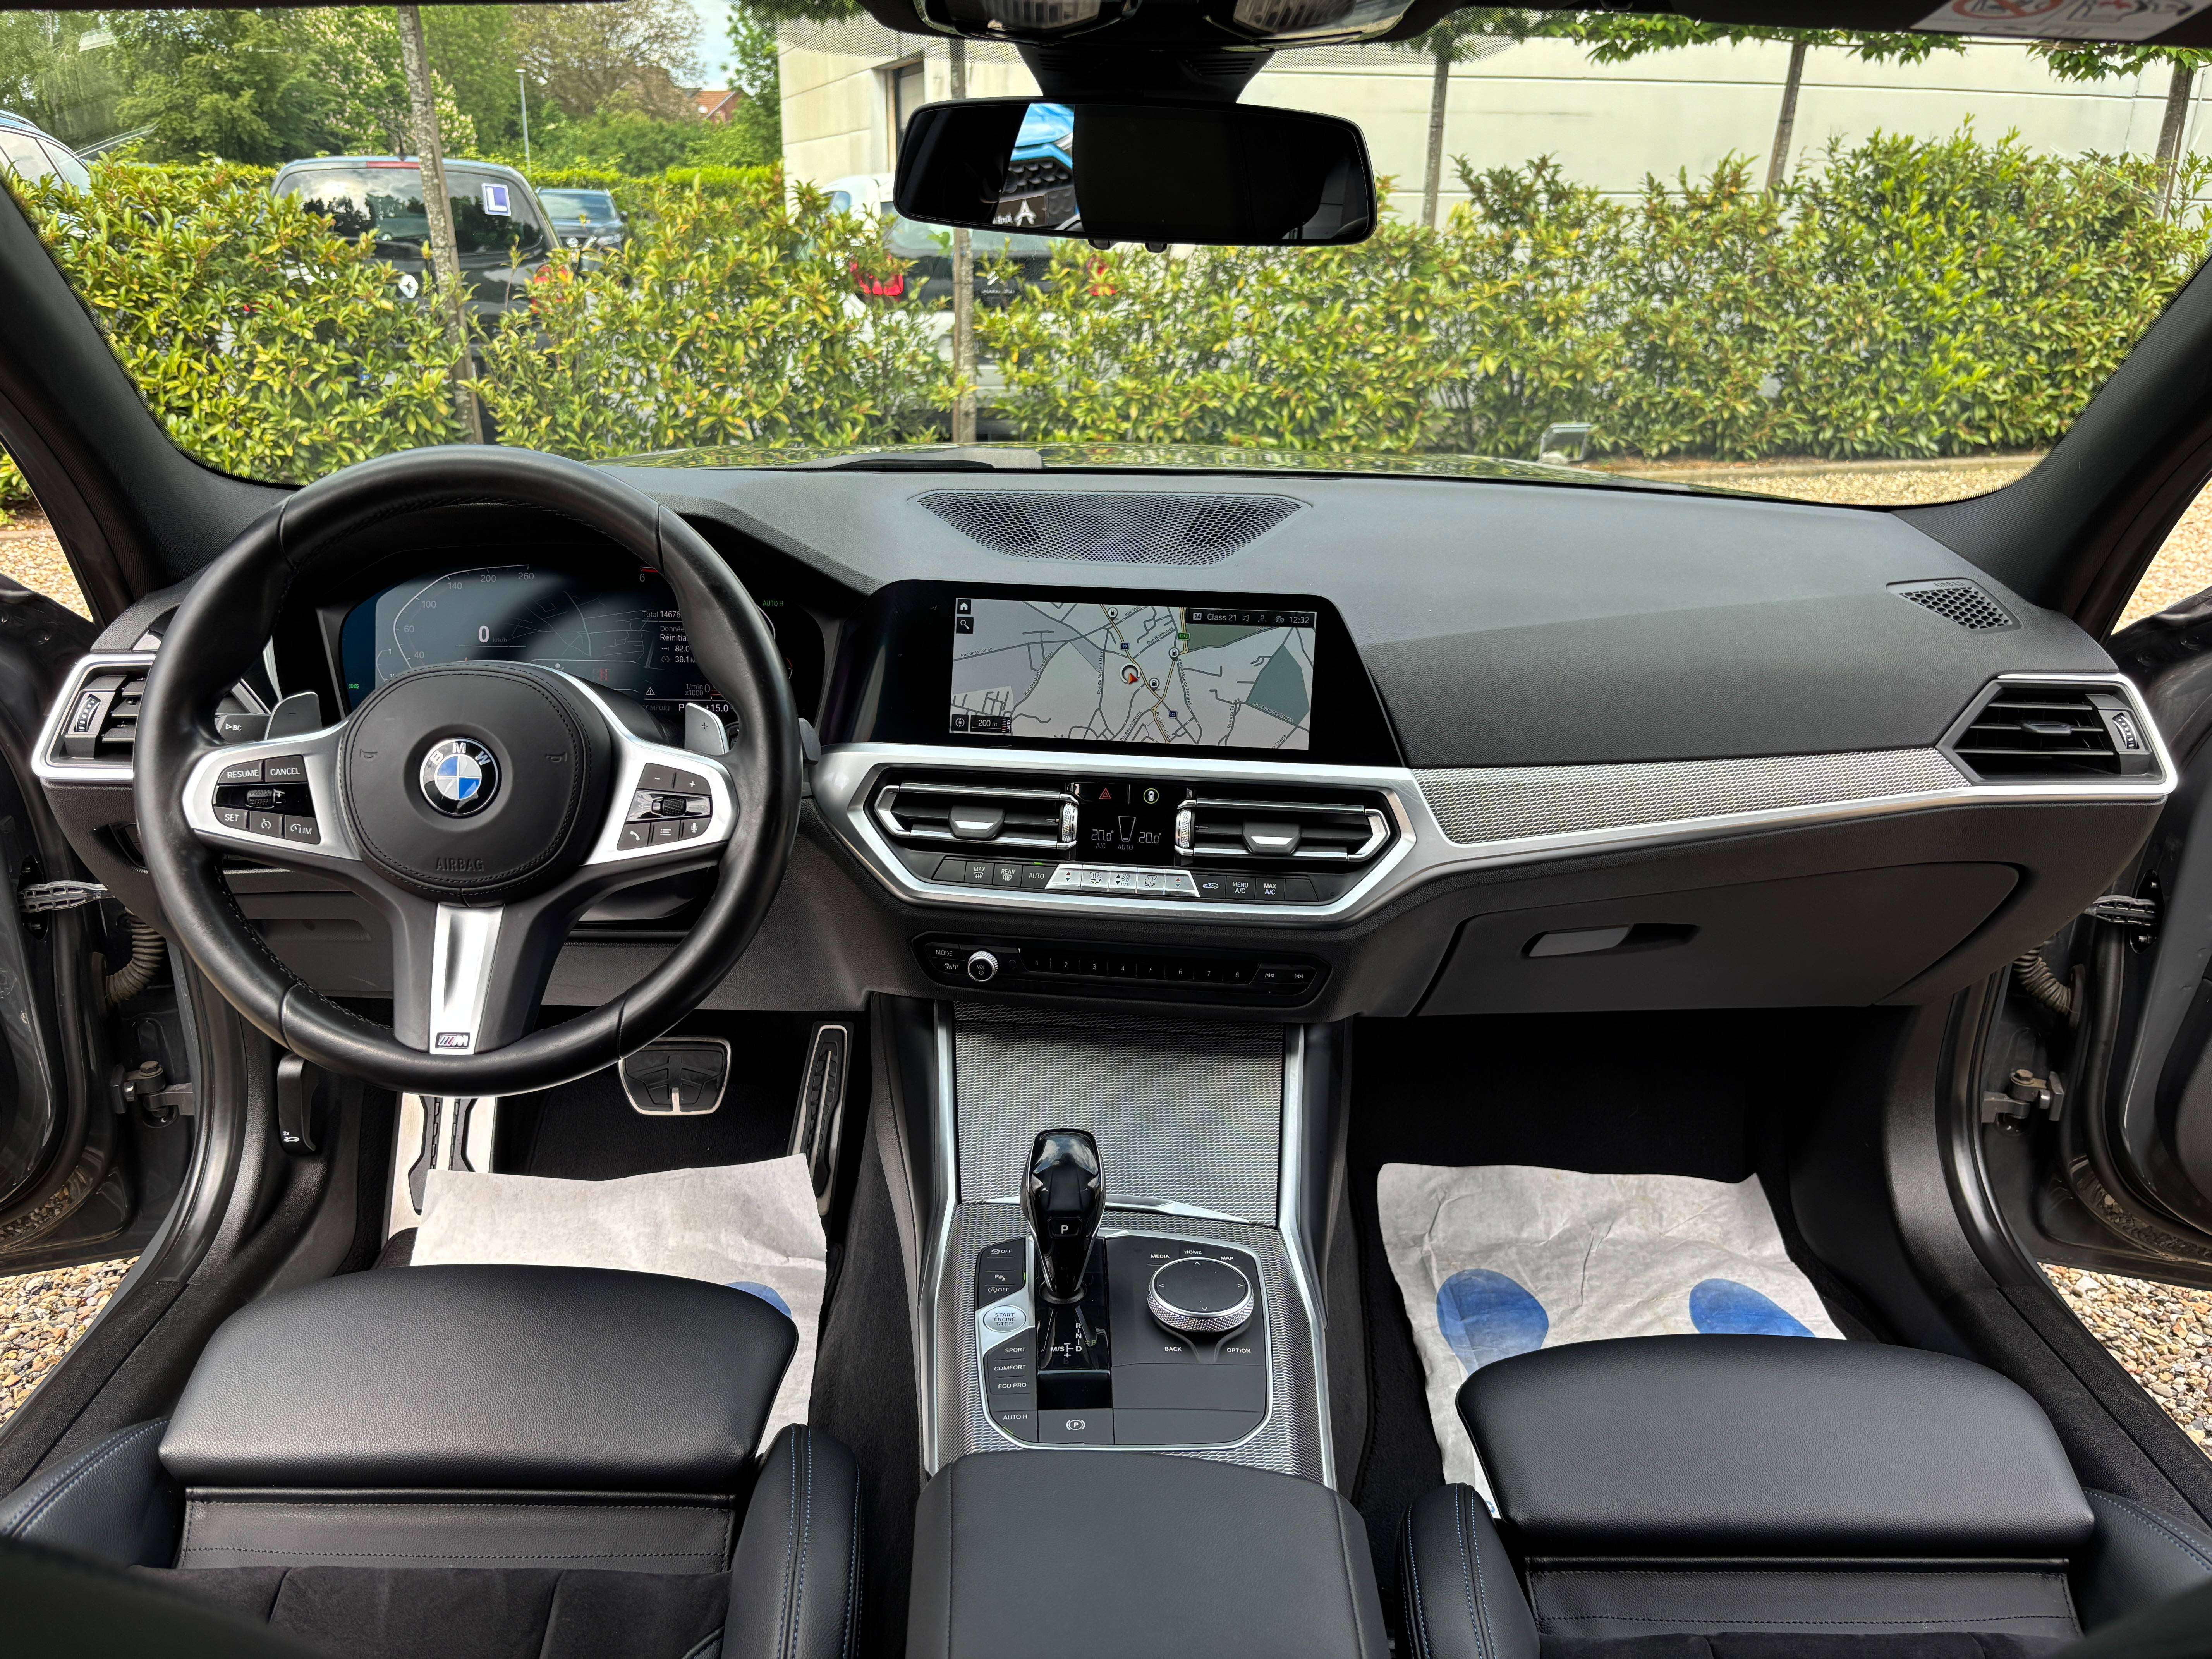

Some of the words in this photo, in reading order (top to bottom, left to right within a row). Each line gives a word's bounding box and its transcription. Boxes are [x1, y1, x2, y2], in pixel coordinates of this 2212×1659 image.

[486, 187, 507, 211] L
[639, 573, 645, 582] 6
[478, 626, 490, 643] 0
[430, 742, 491, 766] BMW
[227, 769, 259, 778] RESUME
[436, 857, 484, 871] AIRBAG
[1061, 1225, 1068, 1234] P
